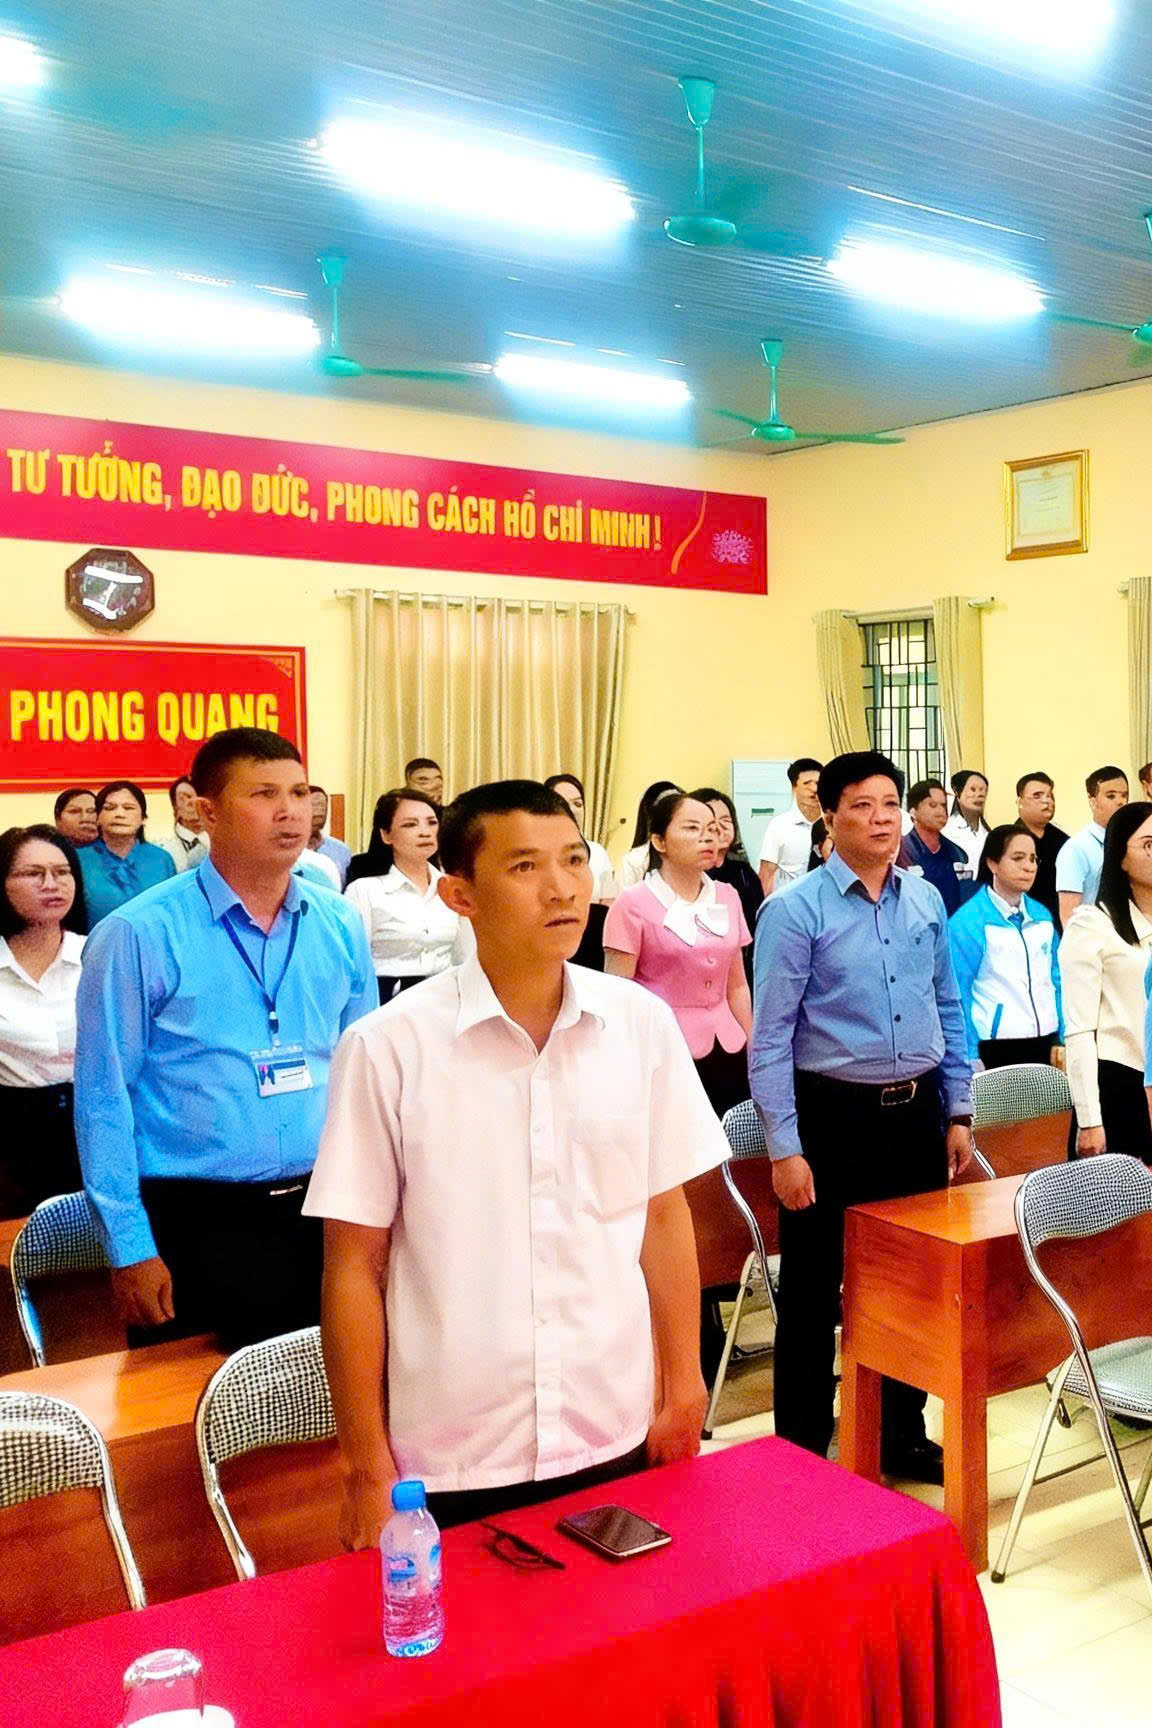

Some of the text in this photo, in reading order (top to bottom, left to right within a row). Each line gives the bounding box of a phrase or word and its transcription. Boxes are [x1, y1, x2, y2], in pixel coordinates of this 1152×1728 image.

[7, 448, 50, 494] TƯ
[181, 465, 243, 519] ĐẠO
[252, 463, 318, 523] ĐỨC,
[327, 481, 420, 529] PHONG
[427, 486, 496, 535] CÁCH
[503, 488, 536, 539] HỒ
[543, 499, 583, 543] CHÍ
[10, 690, 279, 746] PHONG QUANG
